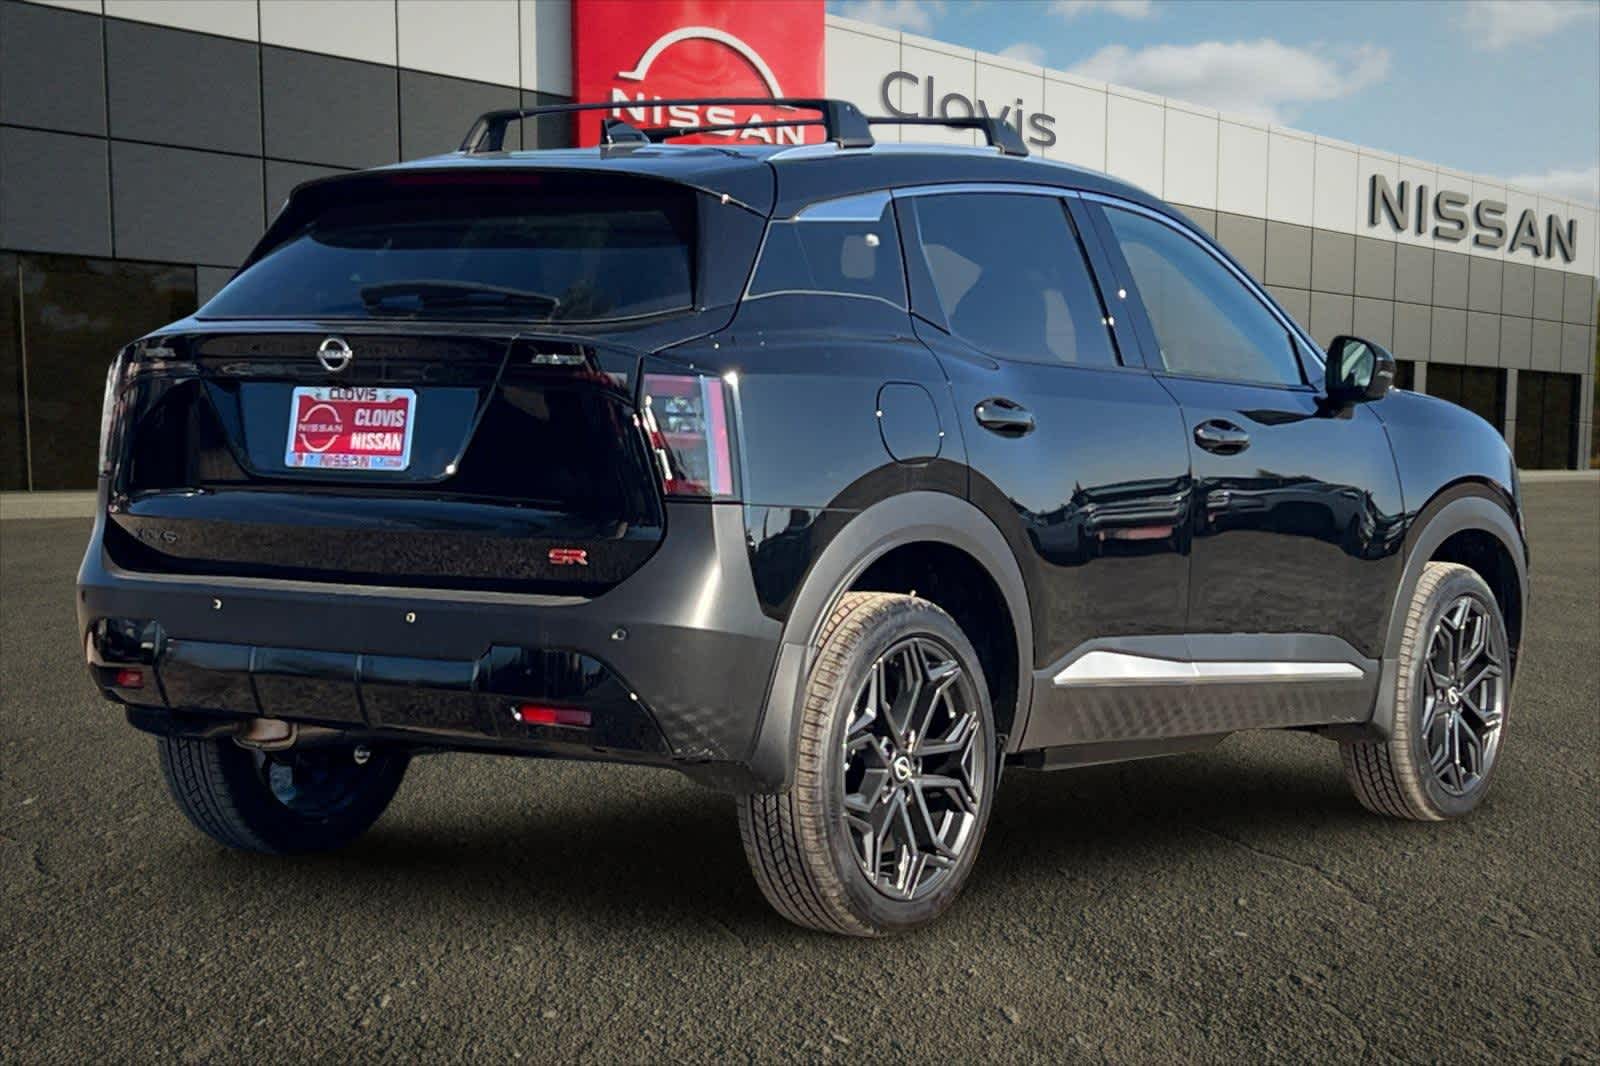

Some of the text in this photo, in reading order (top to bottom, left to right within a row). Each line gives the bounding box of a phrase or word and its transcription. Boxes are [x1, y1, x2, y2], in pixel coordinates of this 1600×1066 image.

[611, 87, 805, 144] NISSAN
[1368, 173, 1577, 263] NISSAN
[330, 388, 377, 401] CLOVIS
[355, 408, 405, 427] CLOVIS
[298, 423, 343, 432] NISSAN
[351, 432, 401, 450] NISSAN
[548, 548, 588, 565] SR
